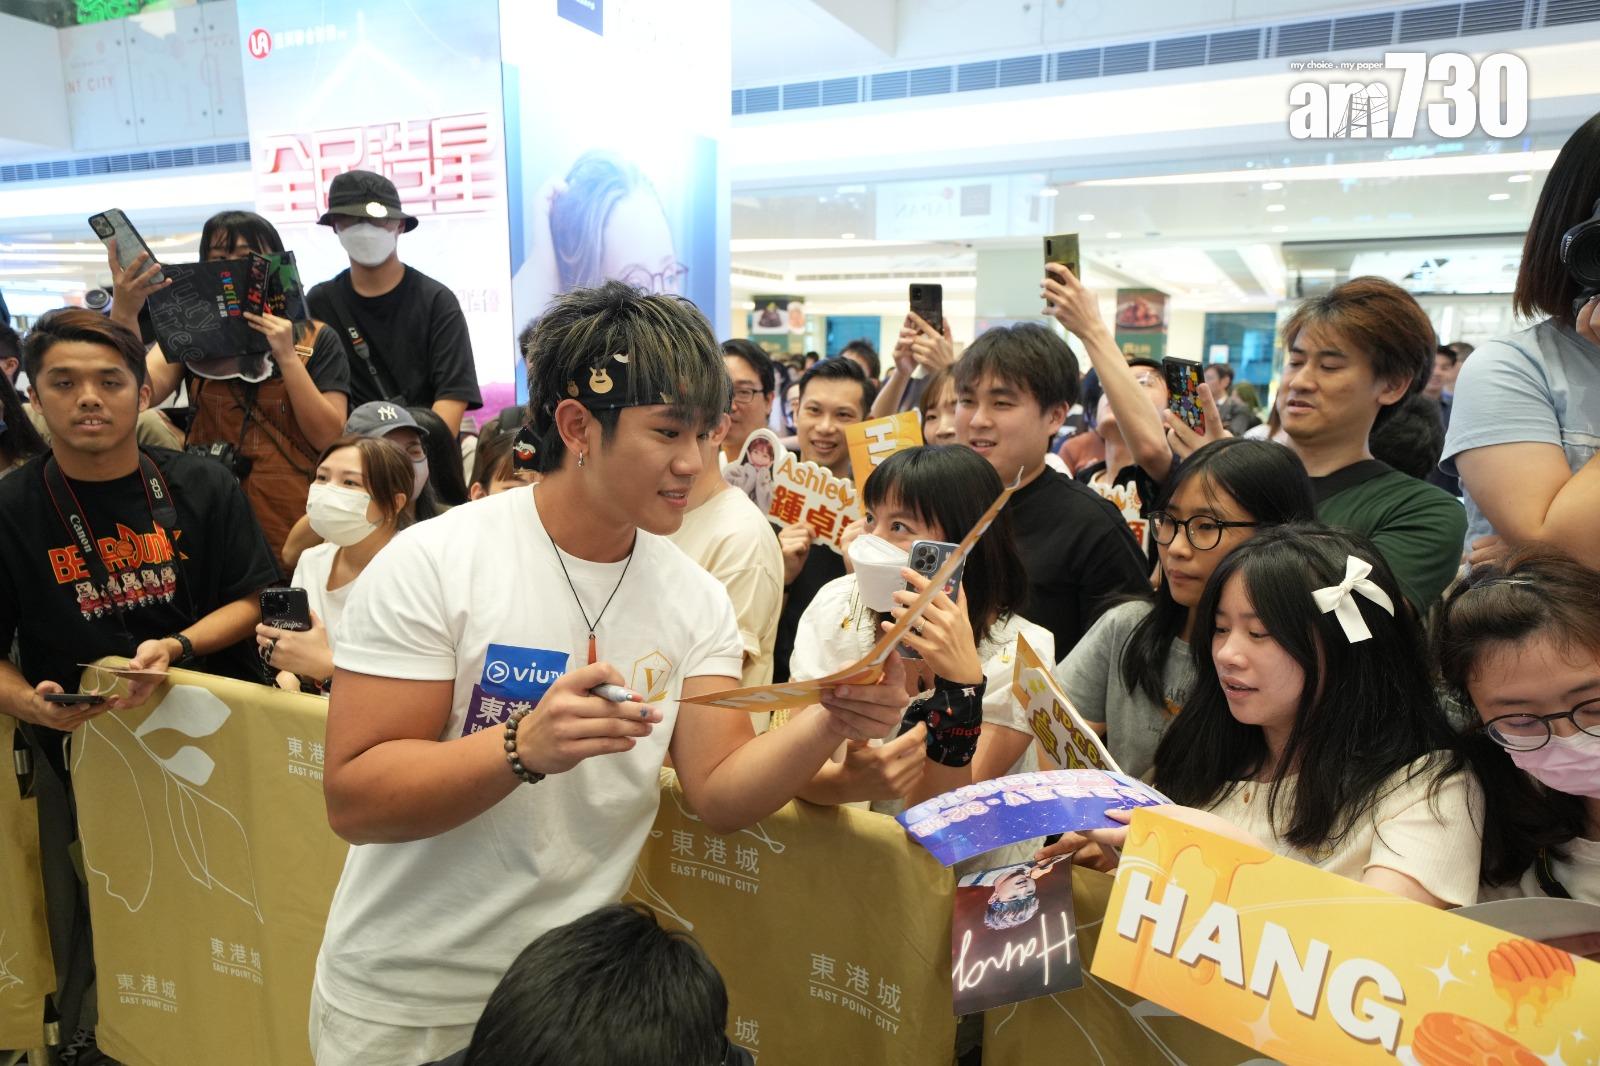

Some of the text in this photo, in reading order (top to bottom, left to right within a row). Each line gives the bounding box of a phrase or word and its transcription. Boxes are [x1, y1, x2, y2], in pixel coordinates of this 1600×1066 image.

[377, 405, 399, 421] NY
[149, 477, 163, 499] EOS
[69, 513, 92, 553] Canon
[287, 736, 324, 764] 東港
[288, 764, 324, 781] EAST POI
[671, 829, 760, 875] 東港城
[671, 863, 760, 894] EAST POINT CITY
[952, 911, 1076, 992] Hang
[1116, 870, 1407, 1055] HANG
[212, 962, 229, 974] EAST
[230, 967, 252, 980] POINT
[810, 952, 902, 1014] 東港城
[115, 974, 177, 1000] 東港城
[119, 996, 178, 1014] EAST POINT CITY
[810, 985, 899, 1035] EAST POINT CITY
